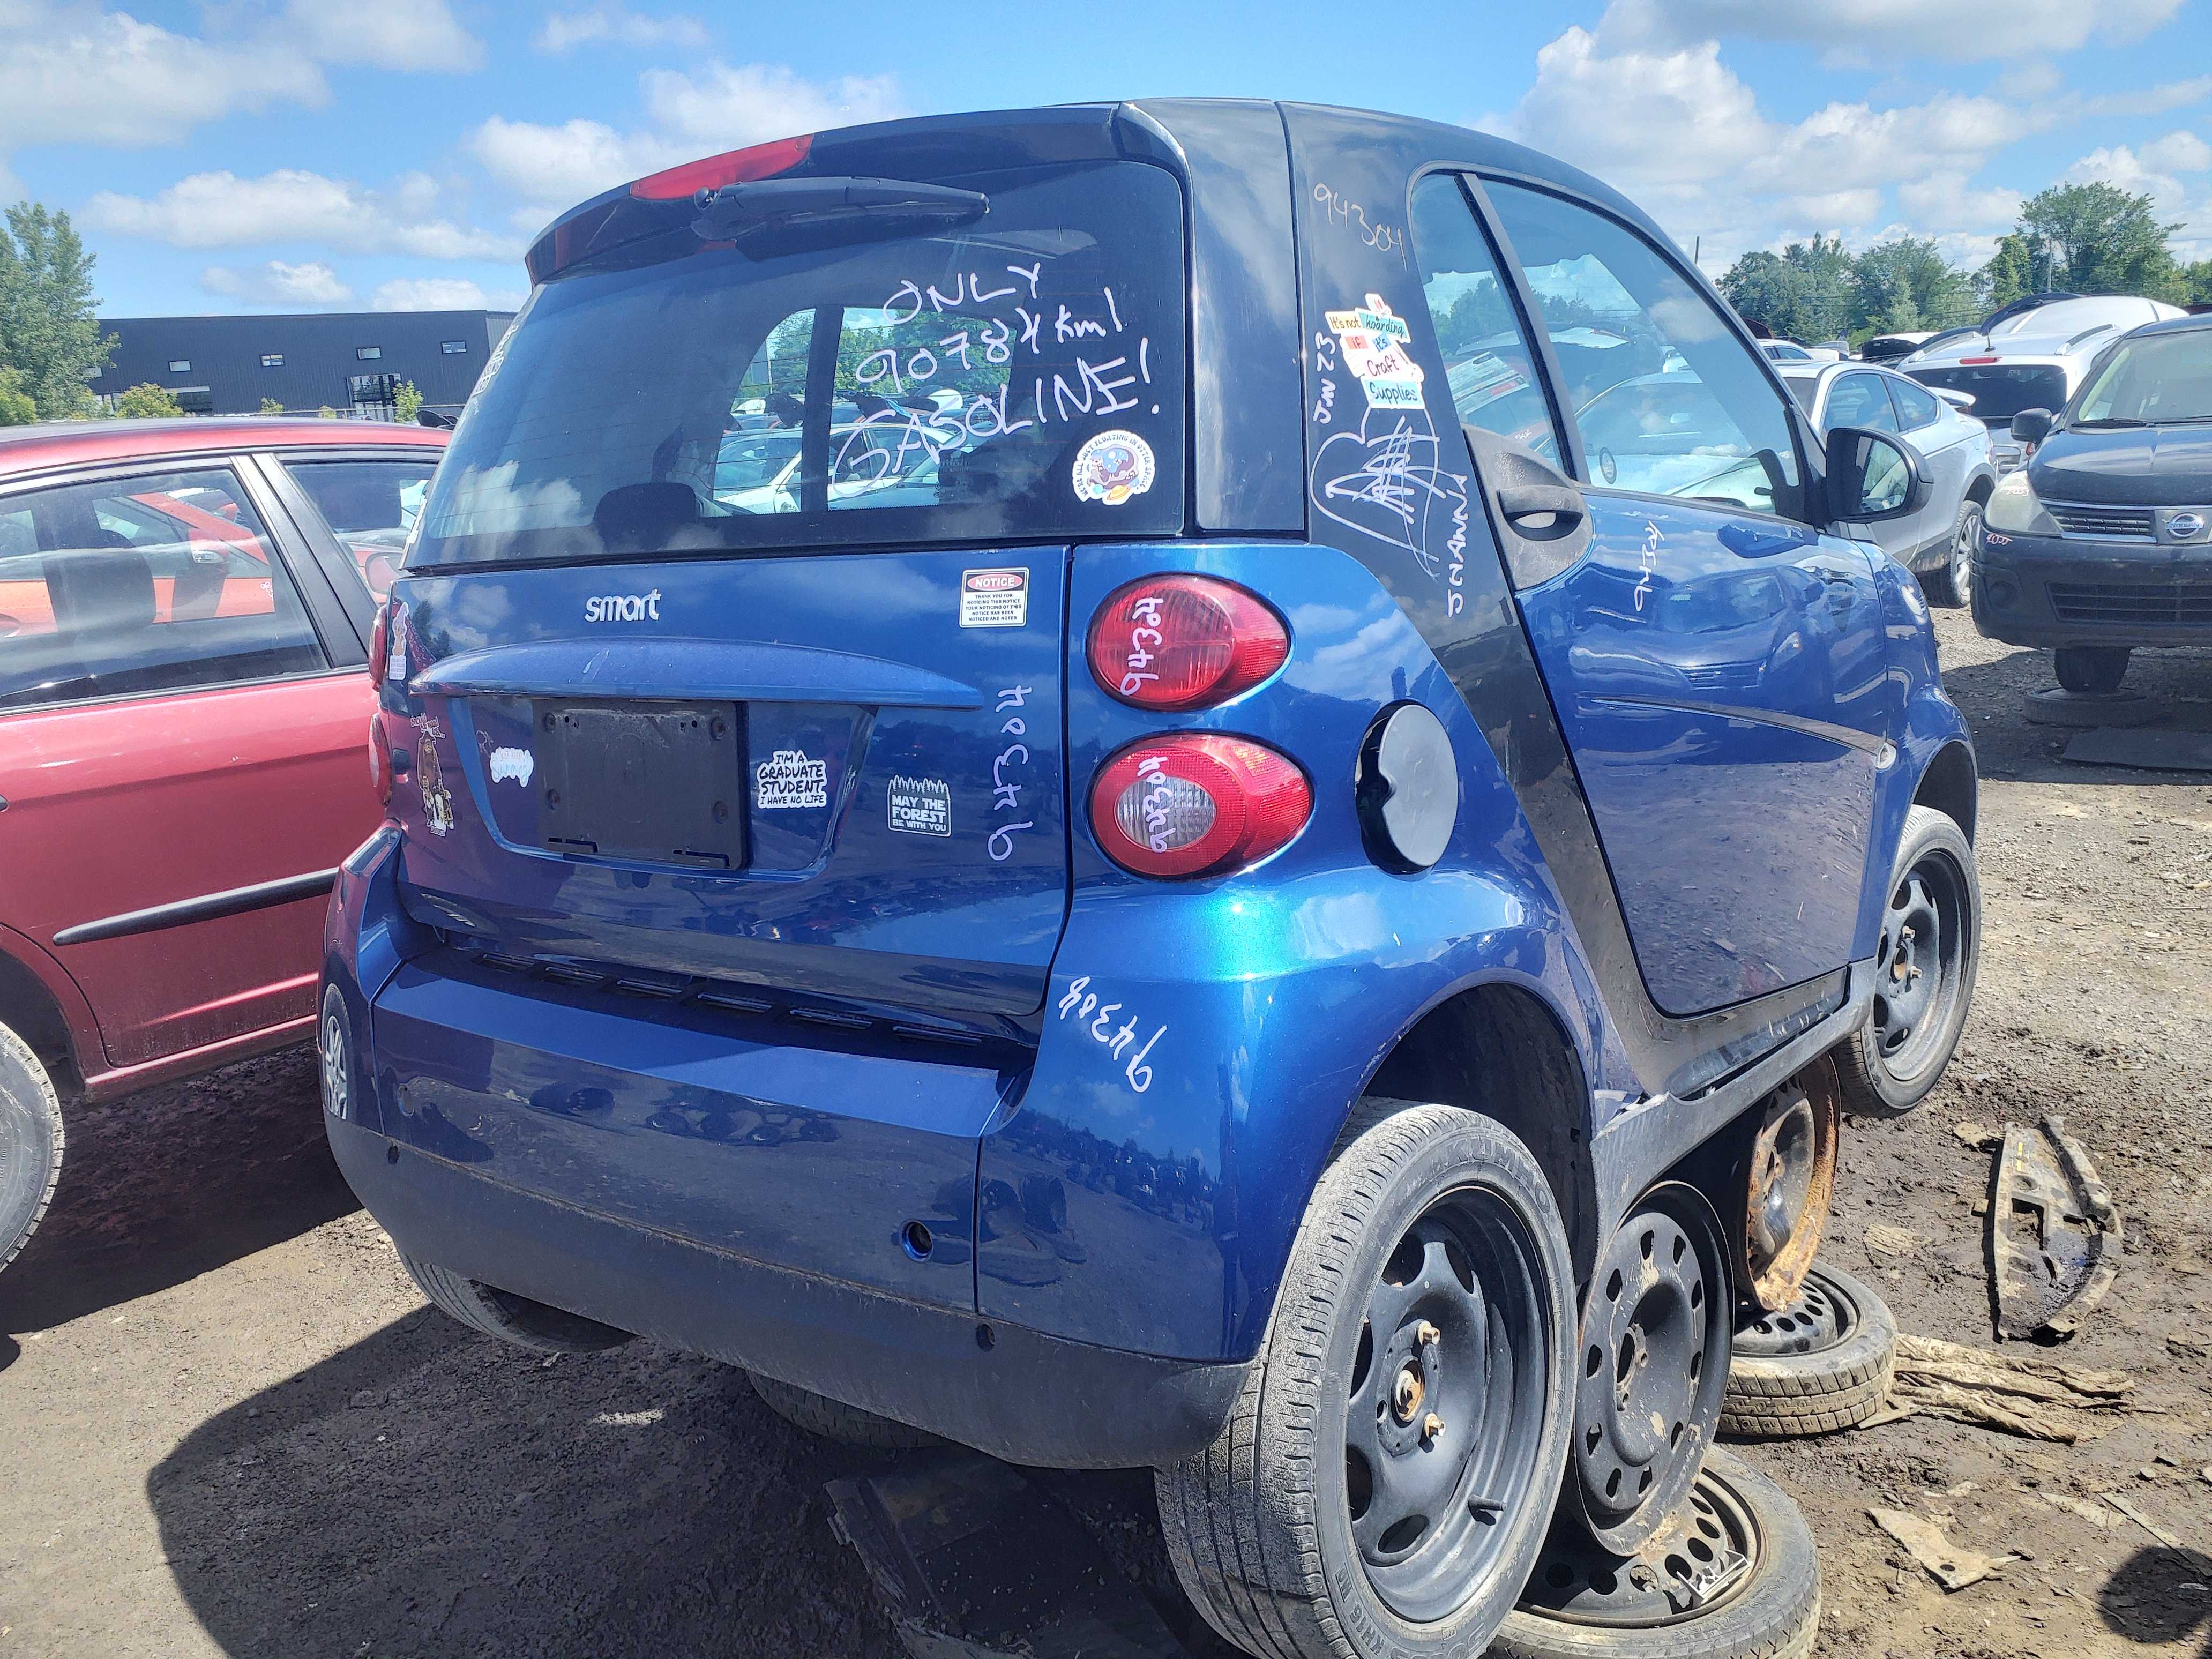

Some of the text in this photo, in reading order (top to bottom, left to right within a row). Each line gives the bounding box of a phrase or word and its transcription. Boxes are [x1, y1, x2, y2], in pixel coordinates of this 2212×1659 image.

[1313, 183, 1407, 272] 94304
[884, 262, 1041, 324] ONLY
[1346, 316, 1359, 329] not
[1366, 314, 1404, 339] hoarding
[1352, 336, 1361, 350] if
[1367, 355, 1398, 377] Craft
[1370, 383, 1418, 404] Supplies
[832, 338, 1160, 498] GASOLINE!
[1082, 444, 1094, 460] JUST
[1094, 434, 1129, 447] FLOATING
[1129, 437, 1137, 446] IN
[975, 577, 1014, 587] NOTICE
[584, 588, 661, 622] smart
[1120, 596, 1164, 697] 94304
[776, 753, 805, 765] I'M A
[759, 764, 824, 780] GRADUATE
[987, 684, 1034, 861] 94304
[761, 779, 824, 794] STUDENT
[767, 797, 787, 805] HAVE
[790, 796, 802, 804] NO
[805, 795, 824, 804] LIFE
[892, 795, 946, 811] MAY THE
[1137, 756, 1172, 853] 94304
[892, 807, 946, 823] FOREST
[892, 819, 947, 832] BE WITH YOU
[1446, 1134, 1550, 1214] KUMHO
[1349, 1603, 1386, 1657] KH16
